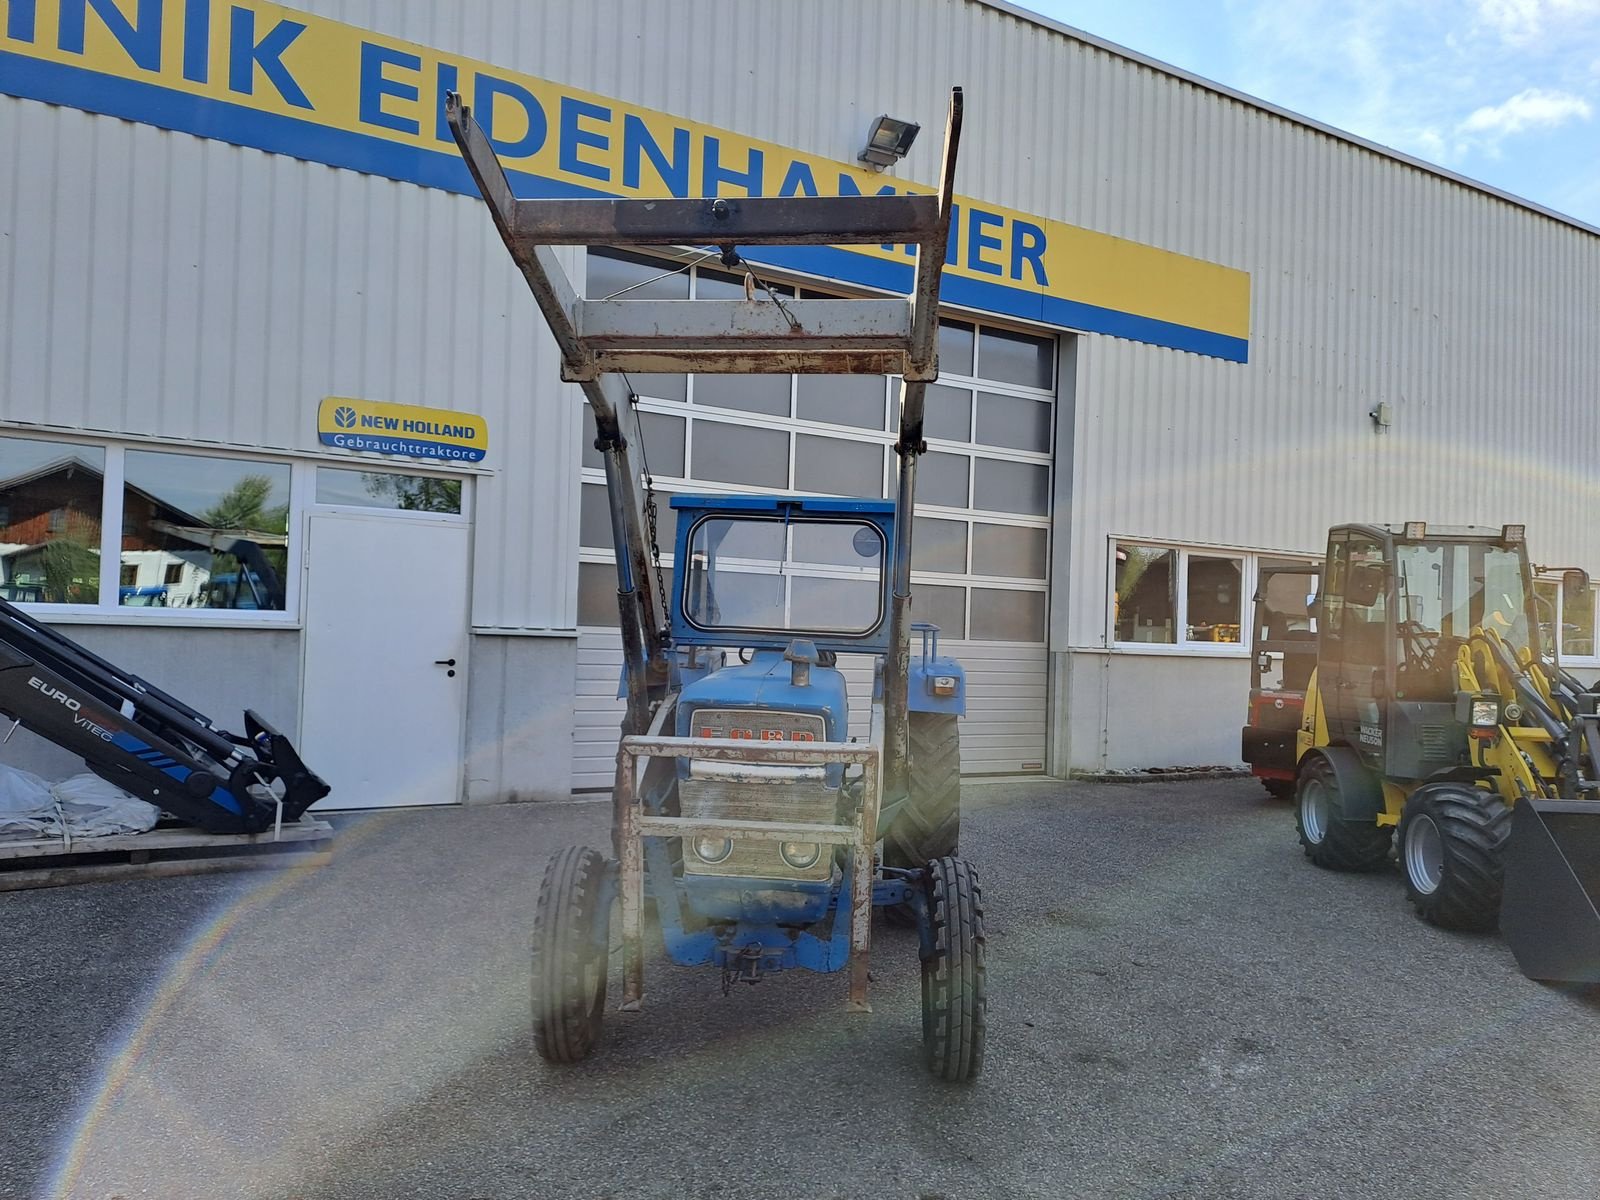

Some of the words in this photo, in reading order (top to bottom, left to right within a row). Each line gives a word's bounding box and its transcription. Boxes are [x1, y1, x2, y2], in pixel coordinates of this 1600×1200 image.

[7, 0, 315, 110] NIK
[359, 41, 1049, 286] EIDENHAER
[361, 415, 399, 430] NEW
[403, 420, 475, 439] HOLLAND
[334, 434, 476, 460] Gebrauchttraktore
[28, 676, 81, 711] EURO
